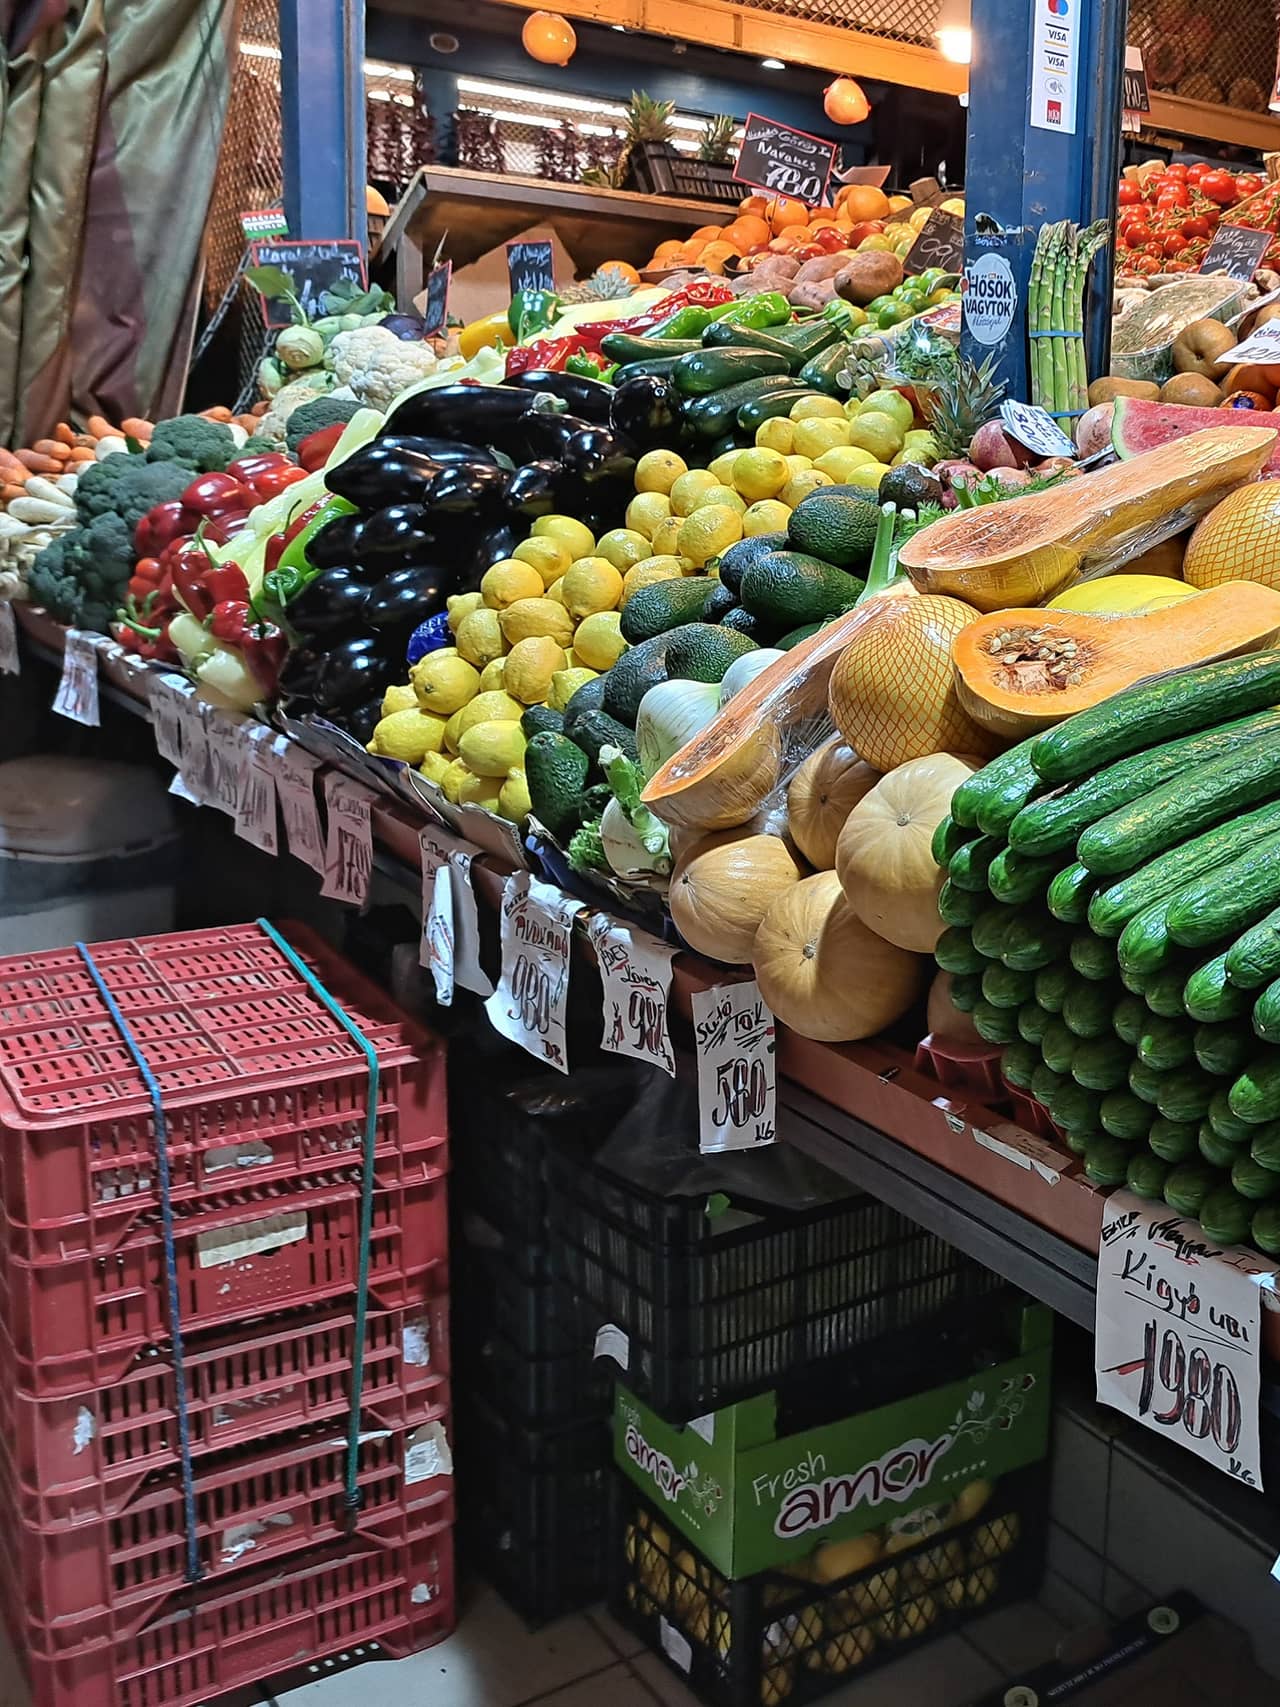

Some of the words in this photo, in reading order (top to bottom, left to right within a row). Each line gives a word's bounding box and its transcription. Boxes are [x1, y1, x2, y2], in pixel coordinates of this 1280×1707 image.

[1047, 56, 1065, 68] VISA
[1048, 30, 1067, 42] VISA
[765, 160, 820, 198] 780
[1101, 1319, 1241, 1454] 1980
[627, 1428, 683, 1500] amor
[752, 1451, 827, 1505] Fresh
[778, 1438, 950, 1535] amor
